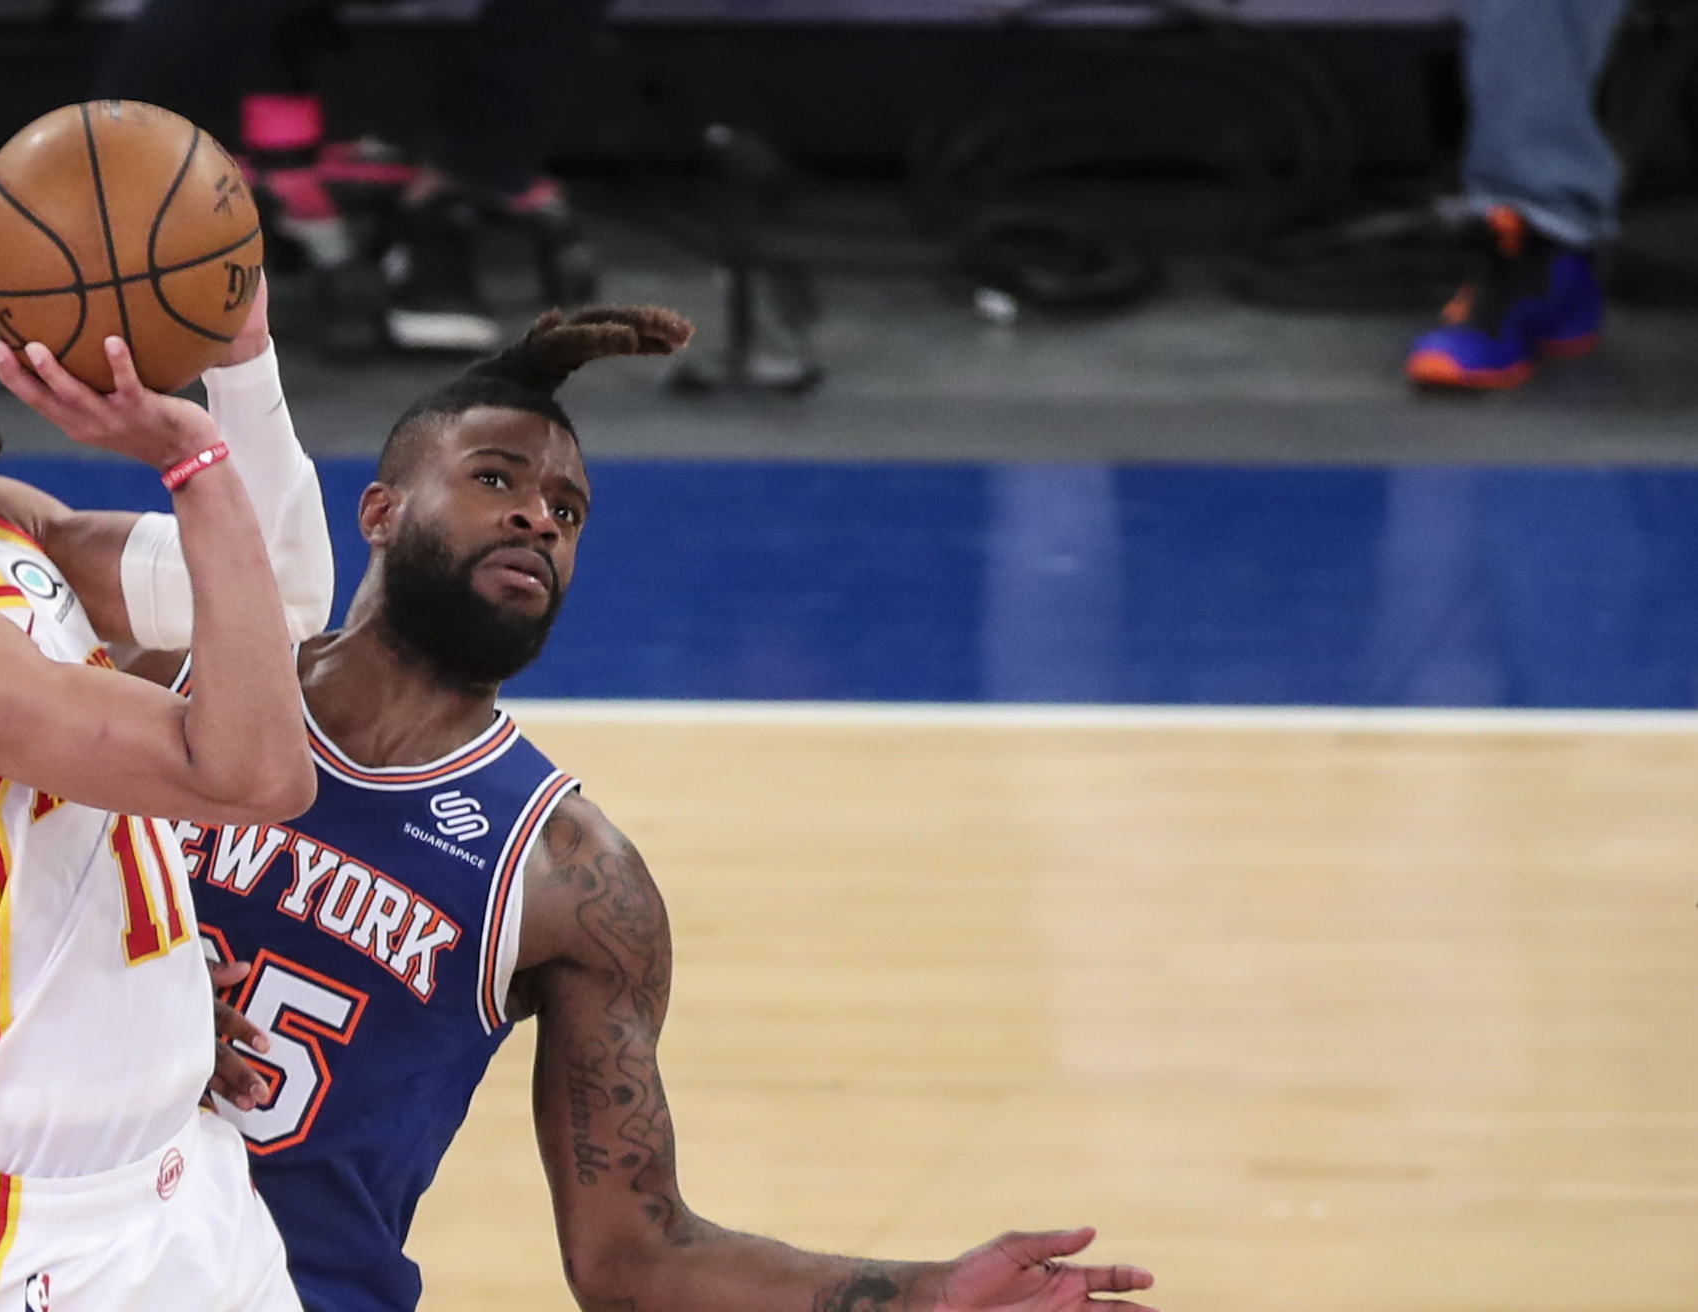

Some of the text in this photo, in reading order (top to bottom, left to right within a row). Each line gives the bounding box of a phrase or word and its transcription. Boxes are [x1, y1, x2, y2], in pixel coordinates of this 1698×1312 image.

[276, 831, 463, 1004] YORK
[403, 822, 486, 870] SQUARESPACE
[199, 922, 369, 1156] 5
